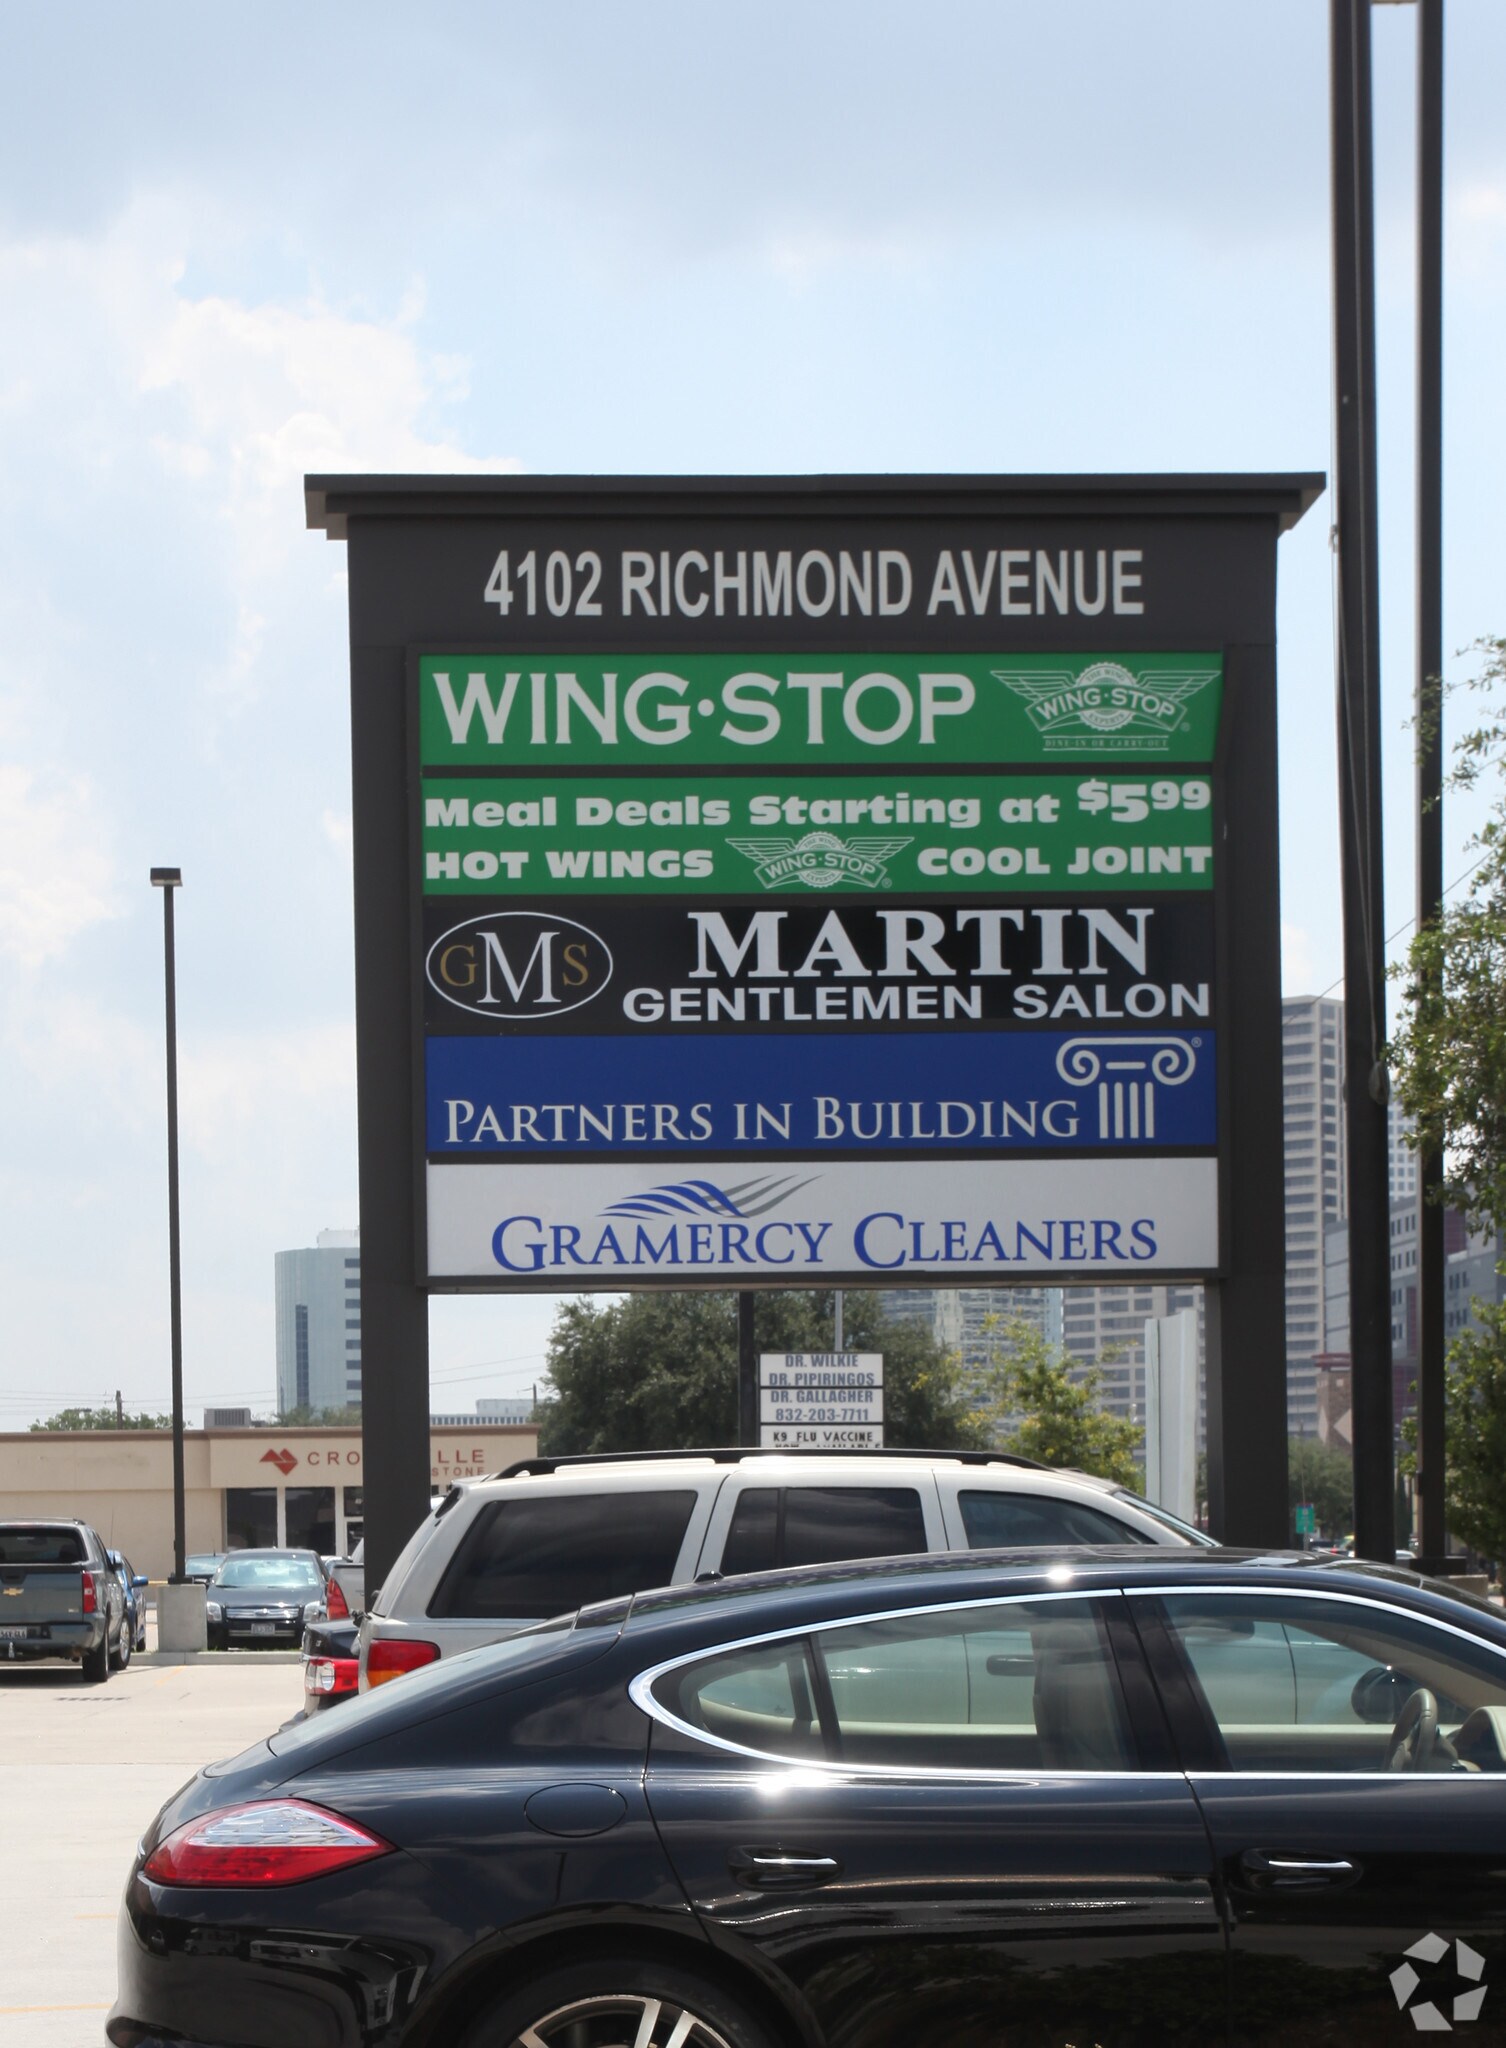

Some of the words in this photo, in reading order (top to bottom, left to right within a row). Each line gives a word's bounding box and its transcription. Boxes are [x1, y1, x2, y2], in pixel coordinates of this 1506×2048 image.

[484, 550, 602, 616] 4102
[621, 549, 912, 617] RICHMOND
[927, 550, 1144, 616] AVENUE
[1091, 738, 1105, 747] OR
[426, 796, 557, 827] Meal
[576, 796, 730, 826] Deals
[749, 792, 980, 828] Starting
[1000, 794, 1060, 823] at
[426, 851, 529, 880] HOT
[545, 850, 714, 878] WINGS
[918, 848, 1050, 875] COOL
[1068, 846, 1212, 874] JOINT
[687, 908, 1154, 978] MARTIN
[440, 930, 590, 1004] GMS
[622, 986, 982, 1022] GENTLEMEN
[1013, 983, 1209, 1019] SALON
[444, 1099, 713, 1143] PARTNERS
[736, 1103, 792, 1140] IN
[814, 1097, 1079, 1139] BUILDING
[491, 1215, 833, 1273] GRAMERCY
[853, 1212, 1158, 1268] CLEANERS
[785, 1354, 808, 1368] DR.
[811, 1354, 859, 1368] WILKIE
[769, 1373, 791, 1386] DR.
[795, 1373, 875, 1386] PIPIRINGOS
[771, 1391, 792, 1403] DR.
[797, 1390, 873, 1403] GALLAGHER
[775, 1408, 869, 1421] 832-203-7711
[773, 1432, 788, 1442] K9
[797, 1432, 817, 1442] FLU
[823, 1432, 873, 1442] VACCINE
